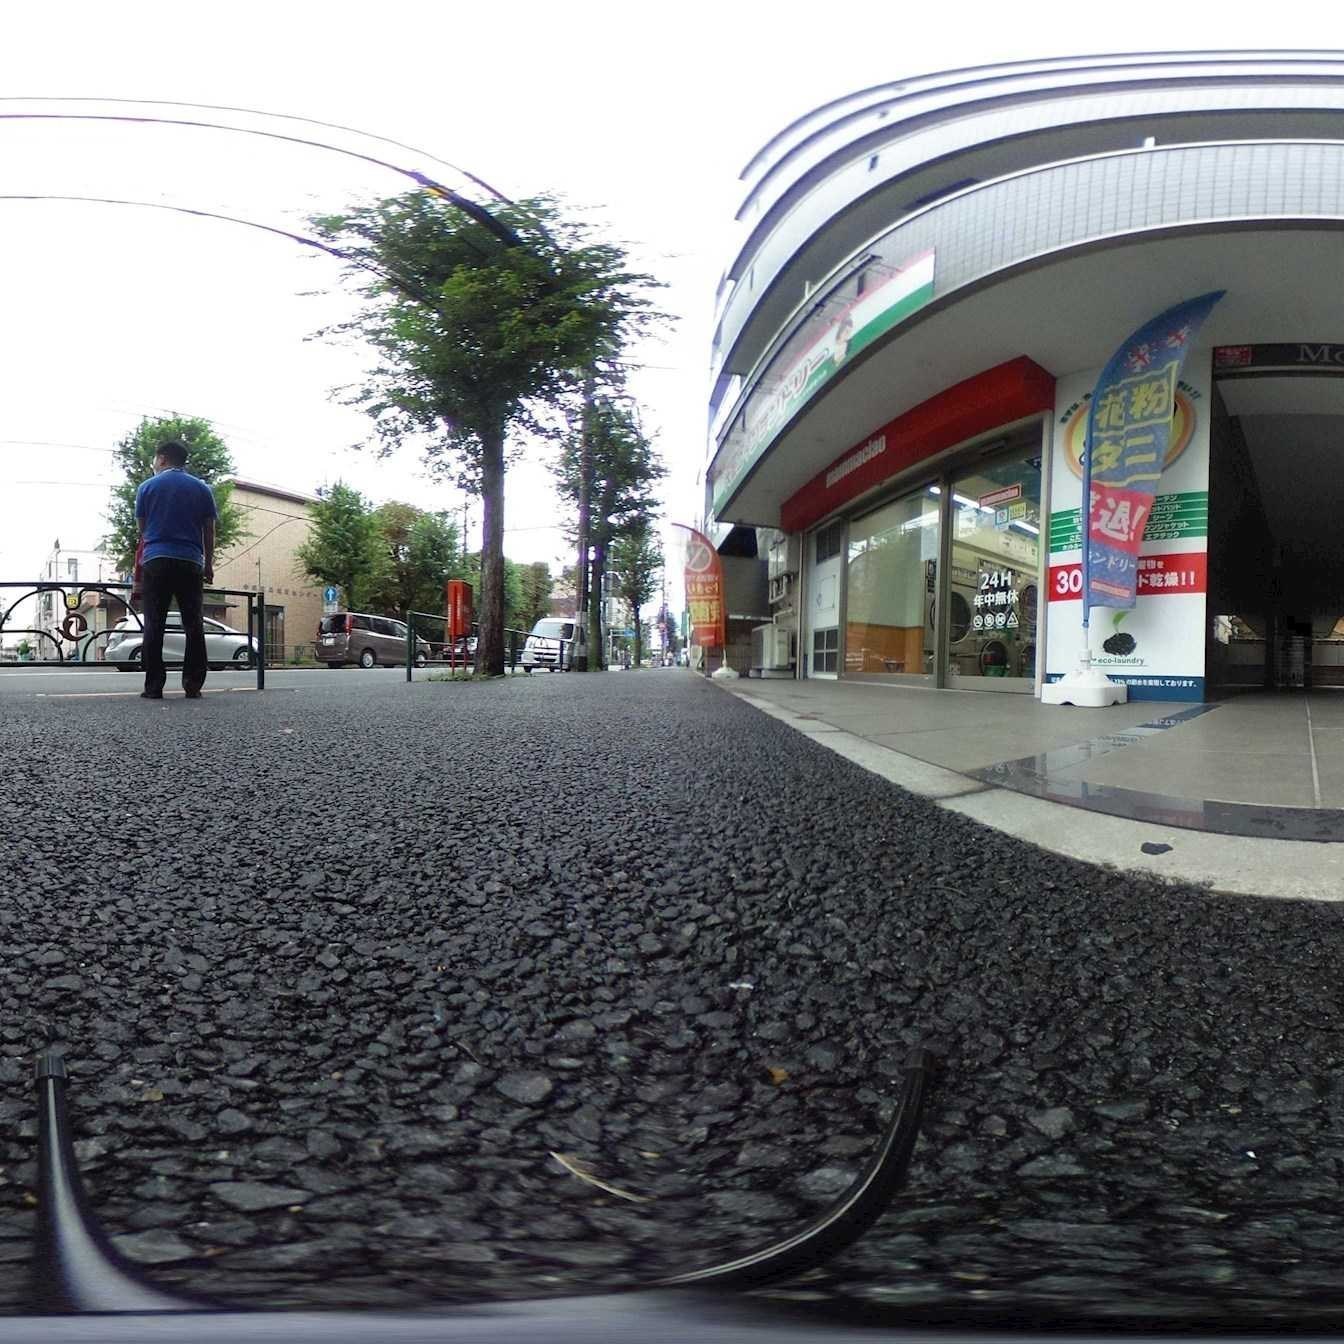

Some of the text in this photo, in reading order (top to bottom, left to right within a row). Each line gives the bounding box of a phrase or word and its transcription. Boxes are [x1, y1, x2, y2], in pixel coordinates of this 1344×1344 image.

[1096, 380, 1169, 429] 花粉
[1090, 490, 1147, 542] 退!
[973, 591, 1019, 608] 年中無休
[1056, 569, 1082, 594] 30
